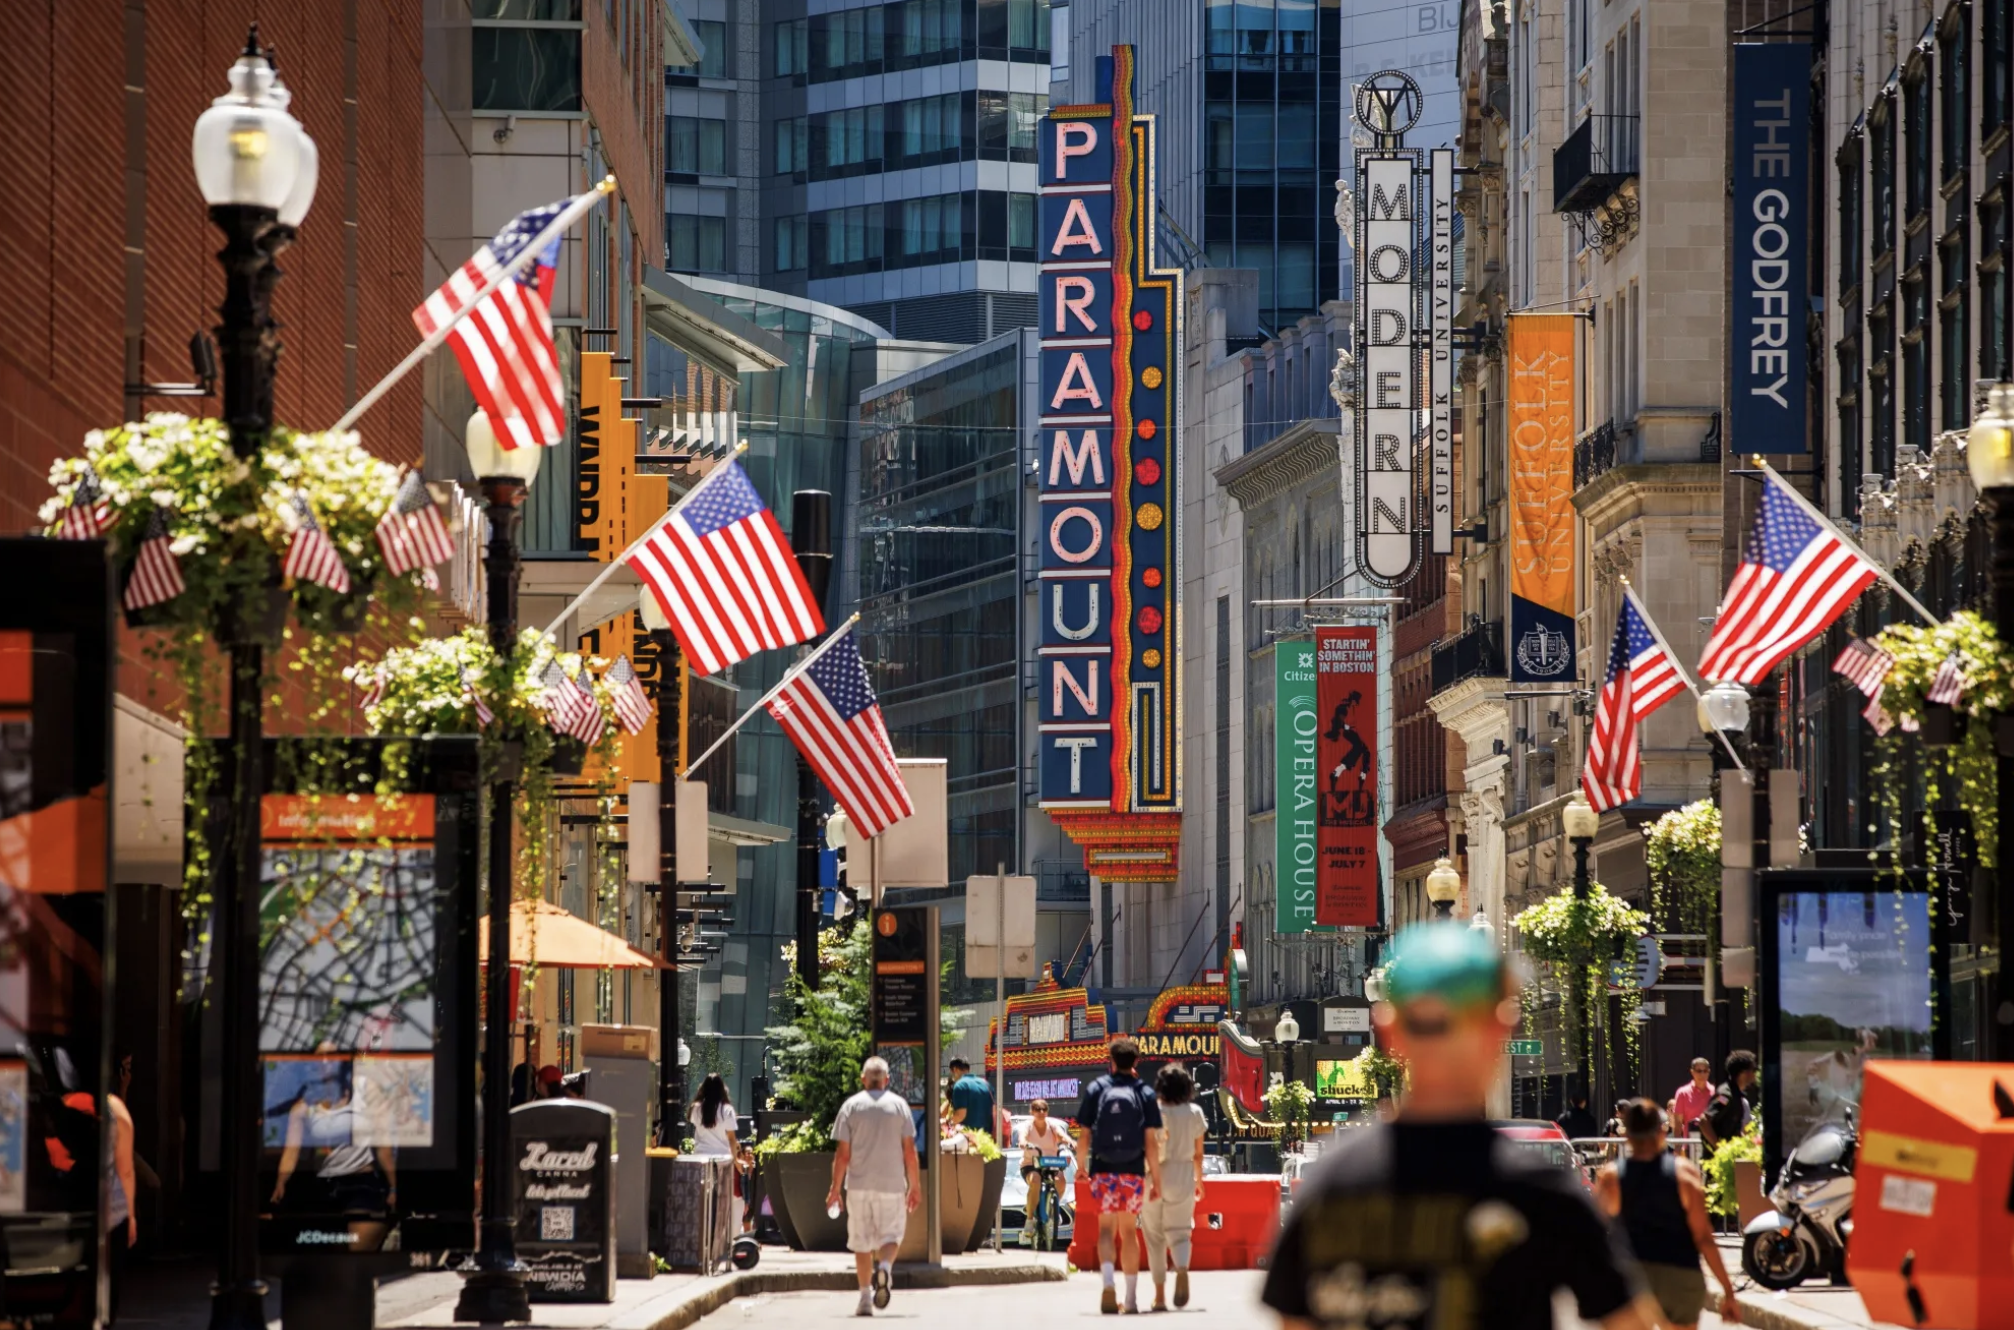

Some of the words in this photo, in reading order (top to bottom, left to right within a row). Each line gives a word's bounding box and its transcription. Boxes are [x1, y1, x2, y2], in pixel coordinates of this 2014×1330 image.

[1753, 88, 1791, 177] THE
[1436, 198, 1449, 362] UNIVERSITY
[1750, 188, 1790, 410] GODFREY
[1369, 183, 1409, 533] MODERN
[1048, 121, 1105, 794] PARAMOUNT
[1435, 393, 1448, 514] SUFFOLK
[1514, 351, 1547, 575] SUFFOLK
[1549, 350, 1572, 575] UNIVERSITY
[1284, 671, 1317, 681] Citize
[1318, 650, 1375, 662] SOMETHIN'
[1319, 662, 1330, 673] IN
[1332, 662, 1374, 673] BOSTON
[1323, 638, 1370, 650] STARTIN'
[1294, 710, 1317, 813] OPERA
[1326, 792, 1369, 818] MJ
[1294, 820, 1315, 918] HOUSE
[1322, 847, 1352, 855] JUNE
[1355, 847, 1365, 855] 18
[1328, 860, 1355, 869] JULY
[1359, 860, 1366, 868] 7
[1501, 1042, 1522, 1053] EST
[296, 1229, 361, 1244] JCDecaux
